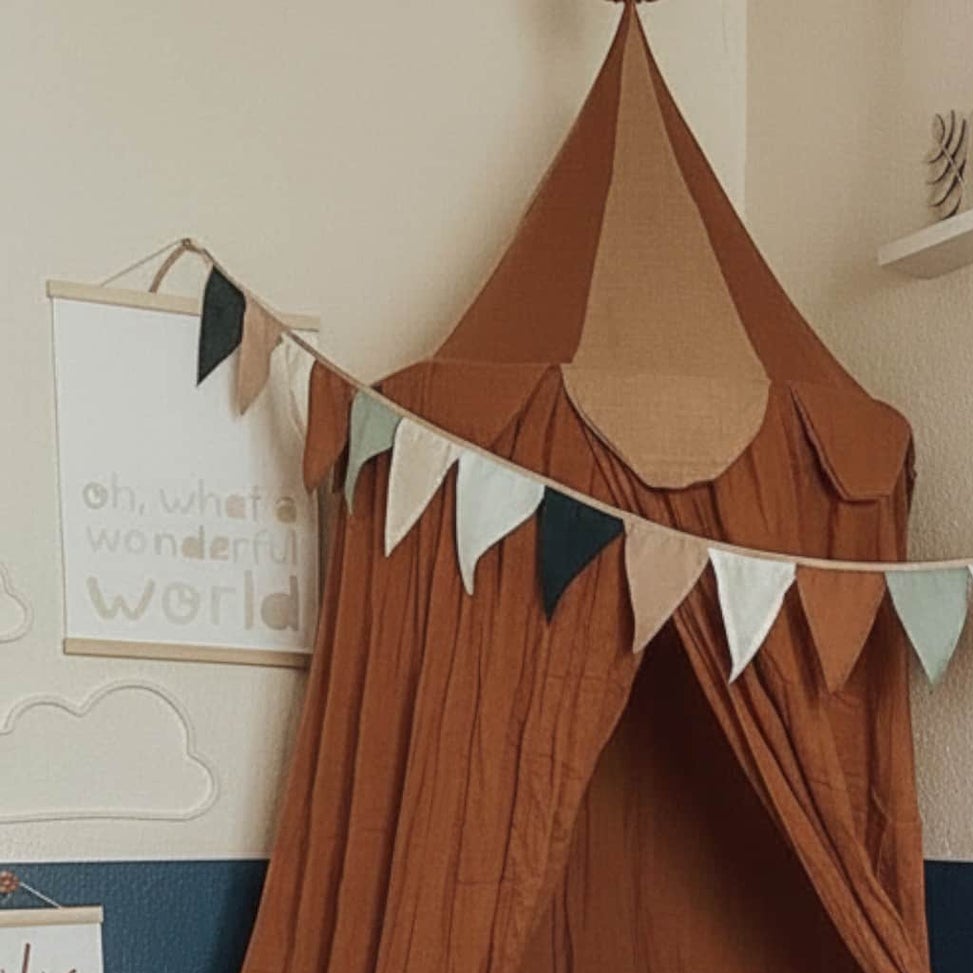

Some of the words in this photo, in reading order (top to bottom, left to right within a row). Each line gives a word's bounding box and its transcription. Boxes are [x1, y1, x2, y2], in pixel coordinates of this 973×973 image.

[82, 470, 145, 515] oh,
[159, 478, 261, 522] what
[274, 495, 298, 523] a
[85, 524, 299, 567] wonderful
[85, 569, 300, 632] world
